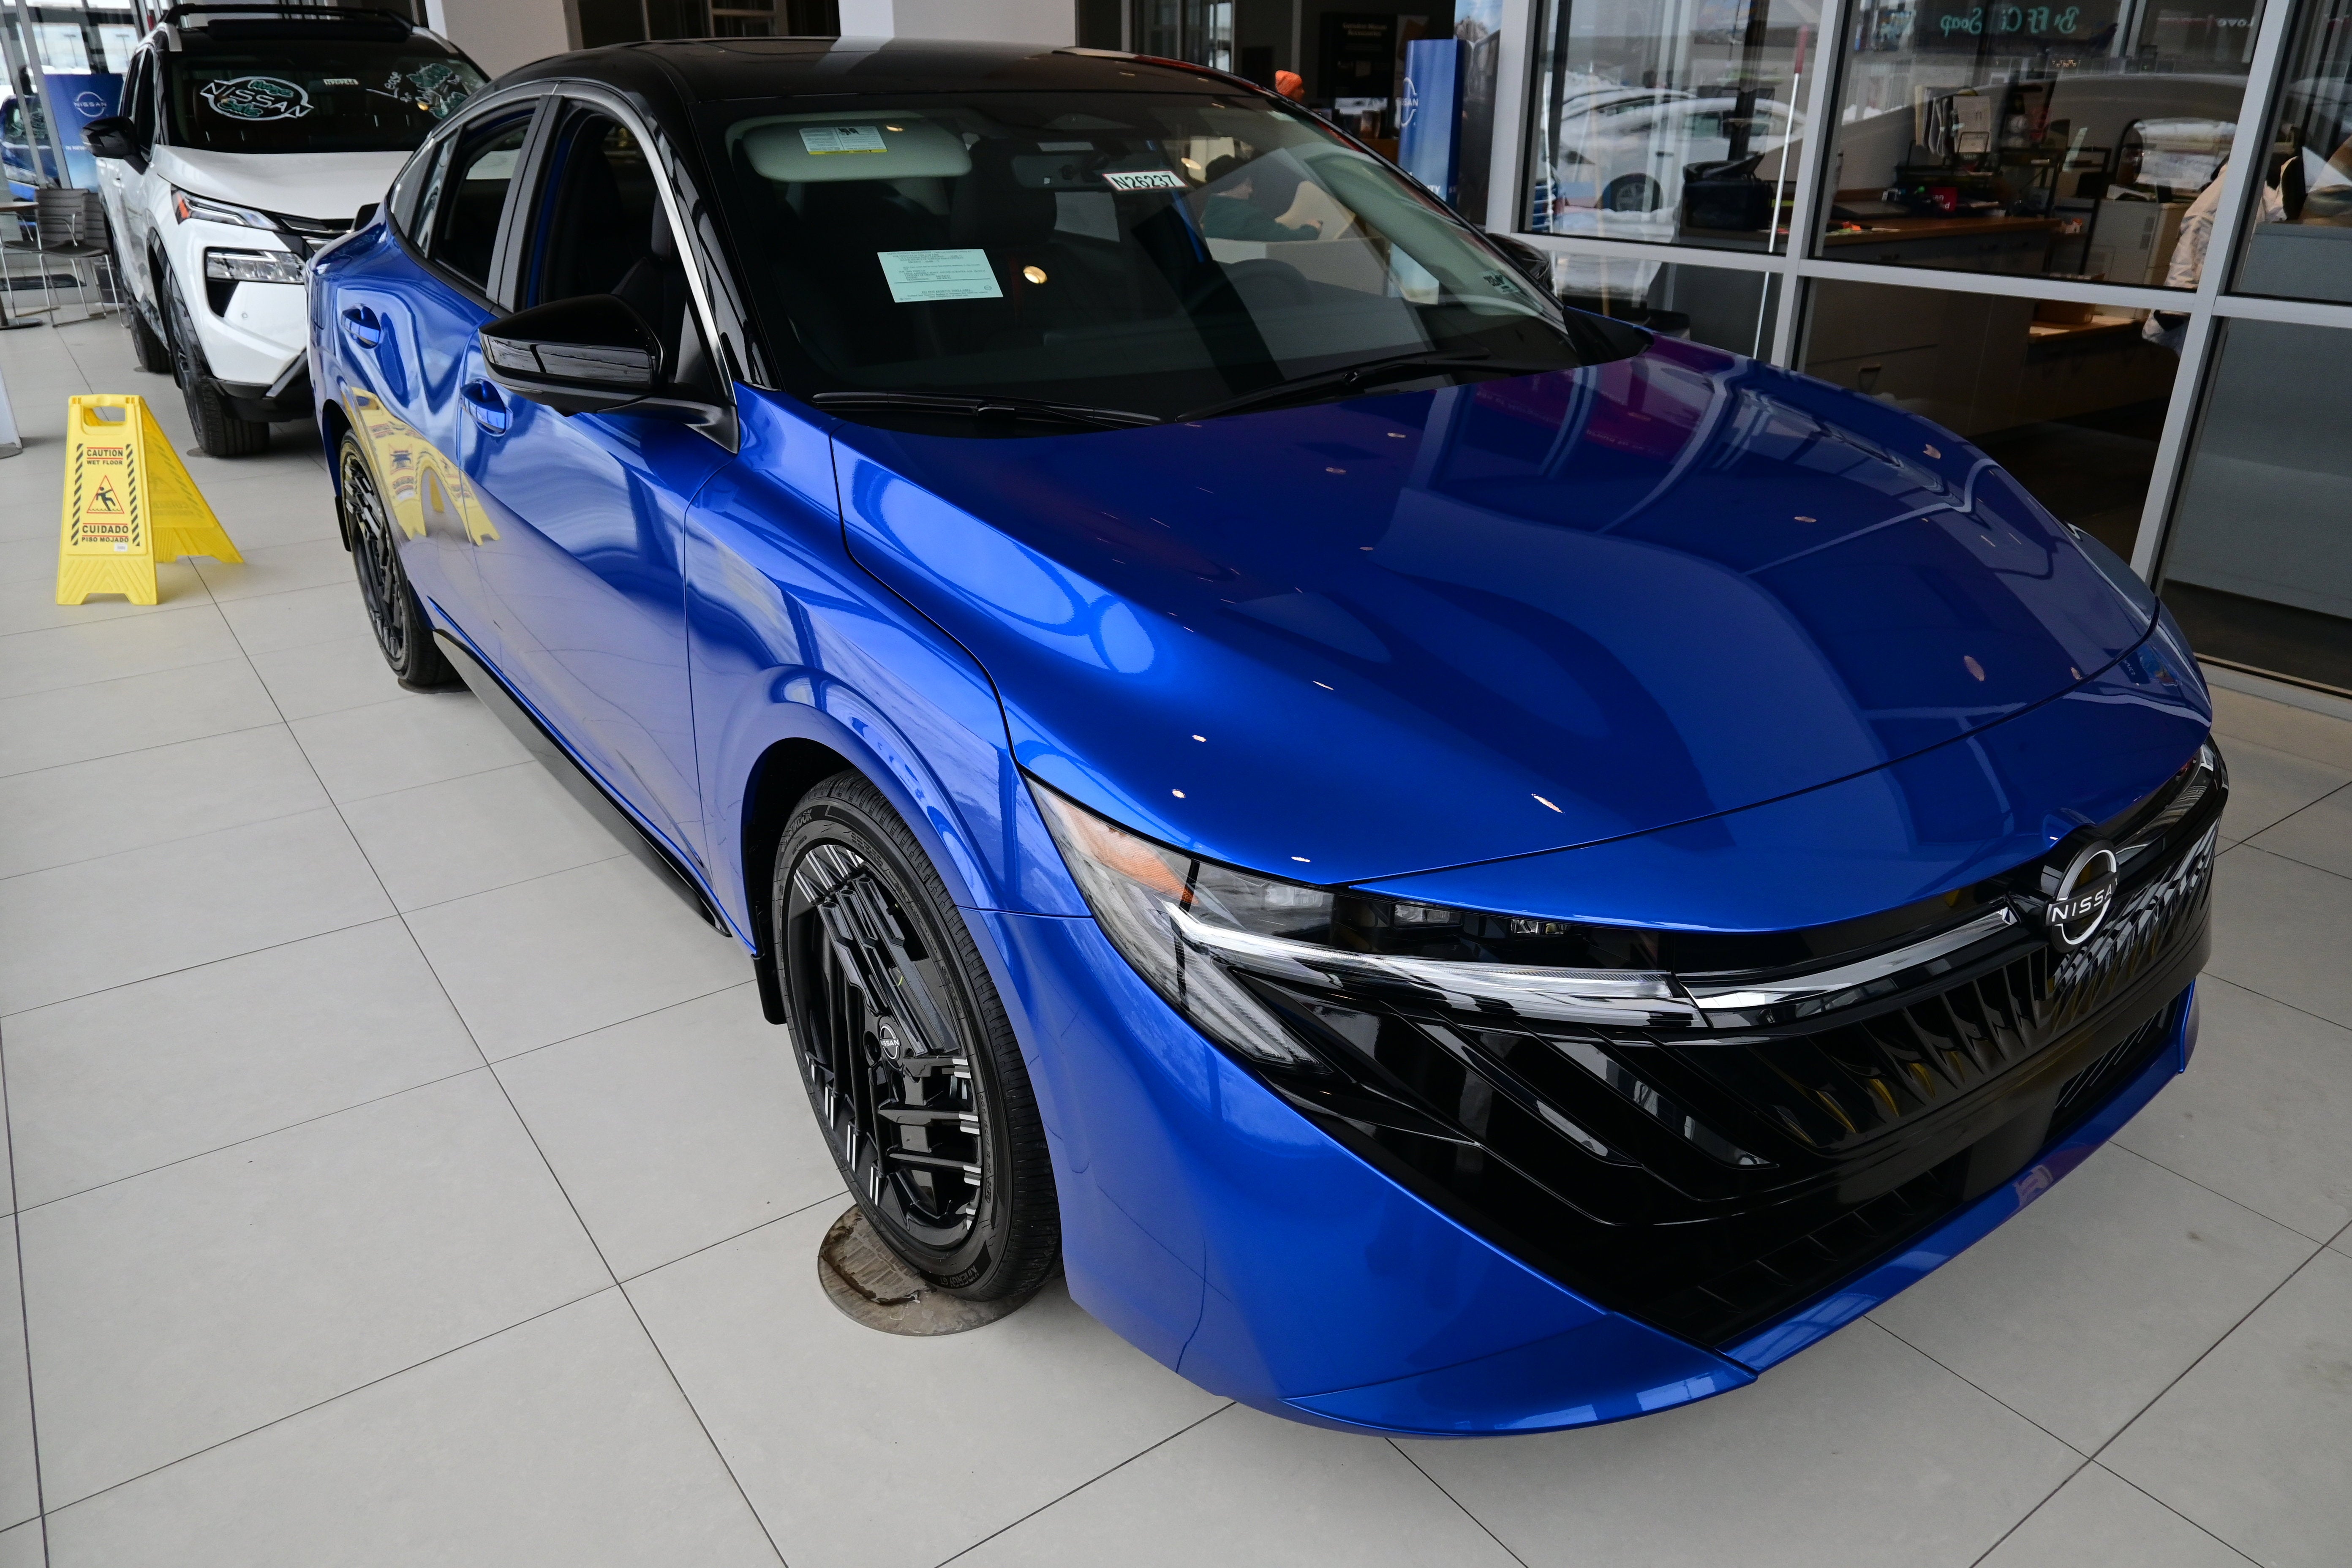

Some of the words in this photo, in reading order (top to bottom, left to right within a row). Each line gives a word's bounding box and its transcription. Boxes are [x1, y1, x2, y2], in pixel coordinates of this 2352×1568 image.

[200, 82, 313, 118] NISSAN
[1111, 174, 1176, 189] N26237
[82, 525, 128, 534] CUIDADO
